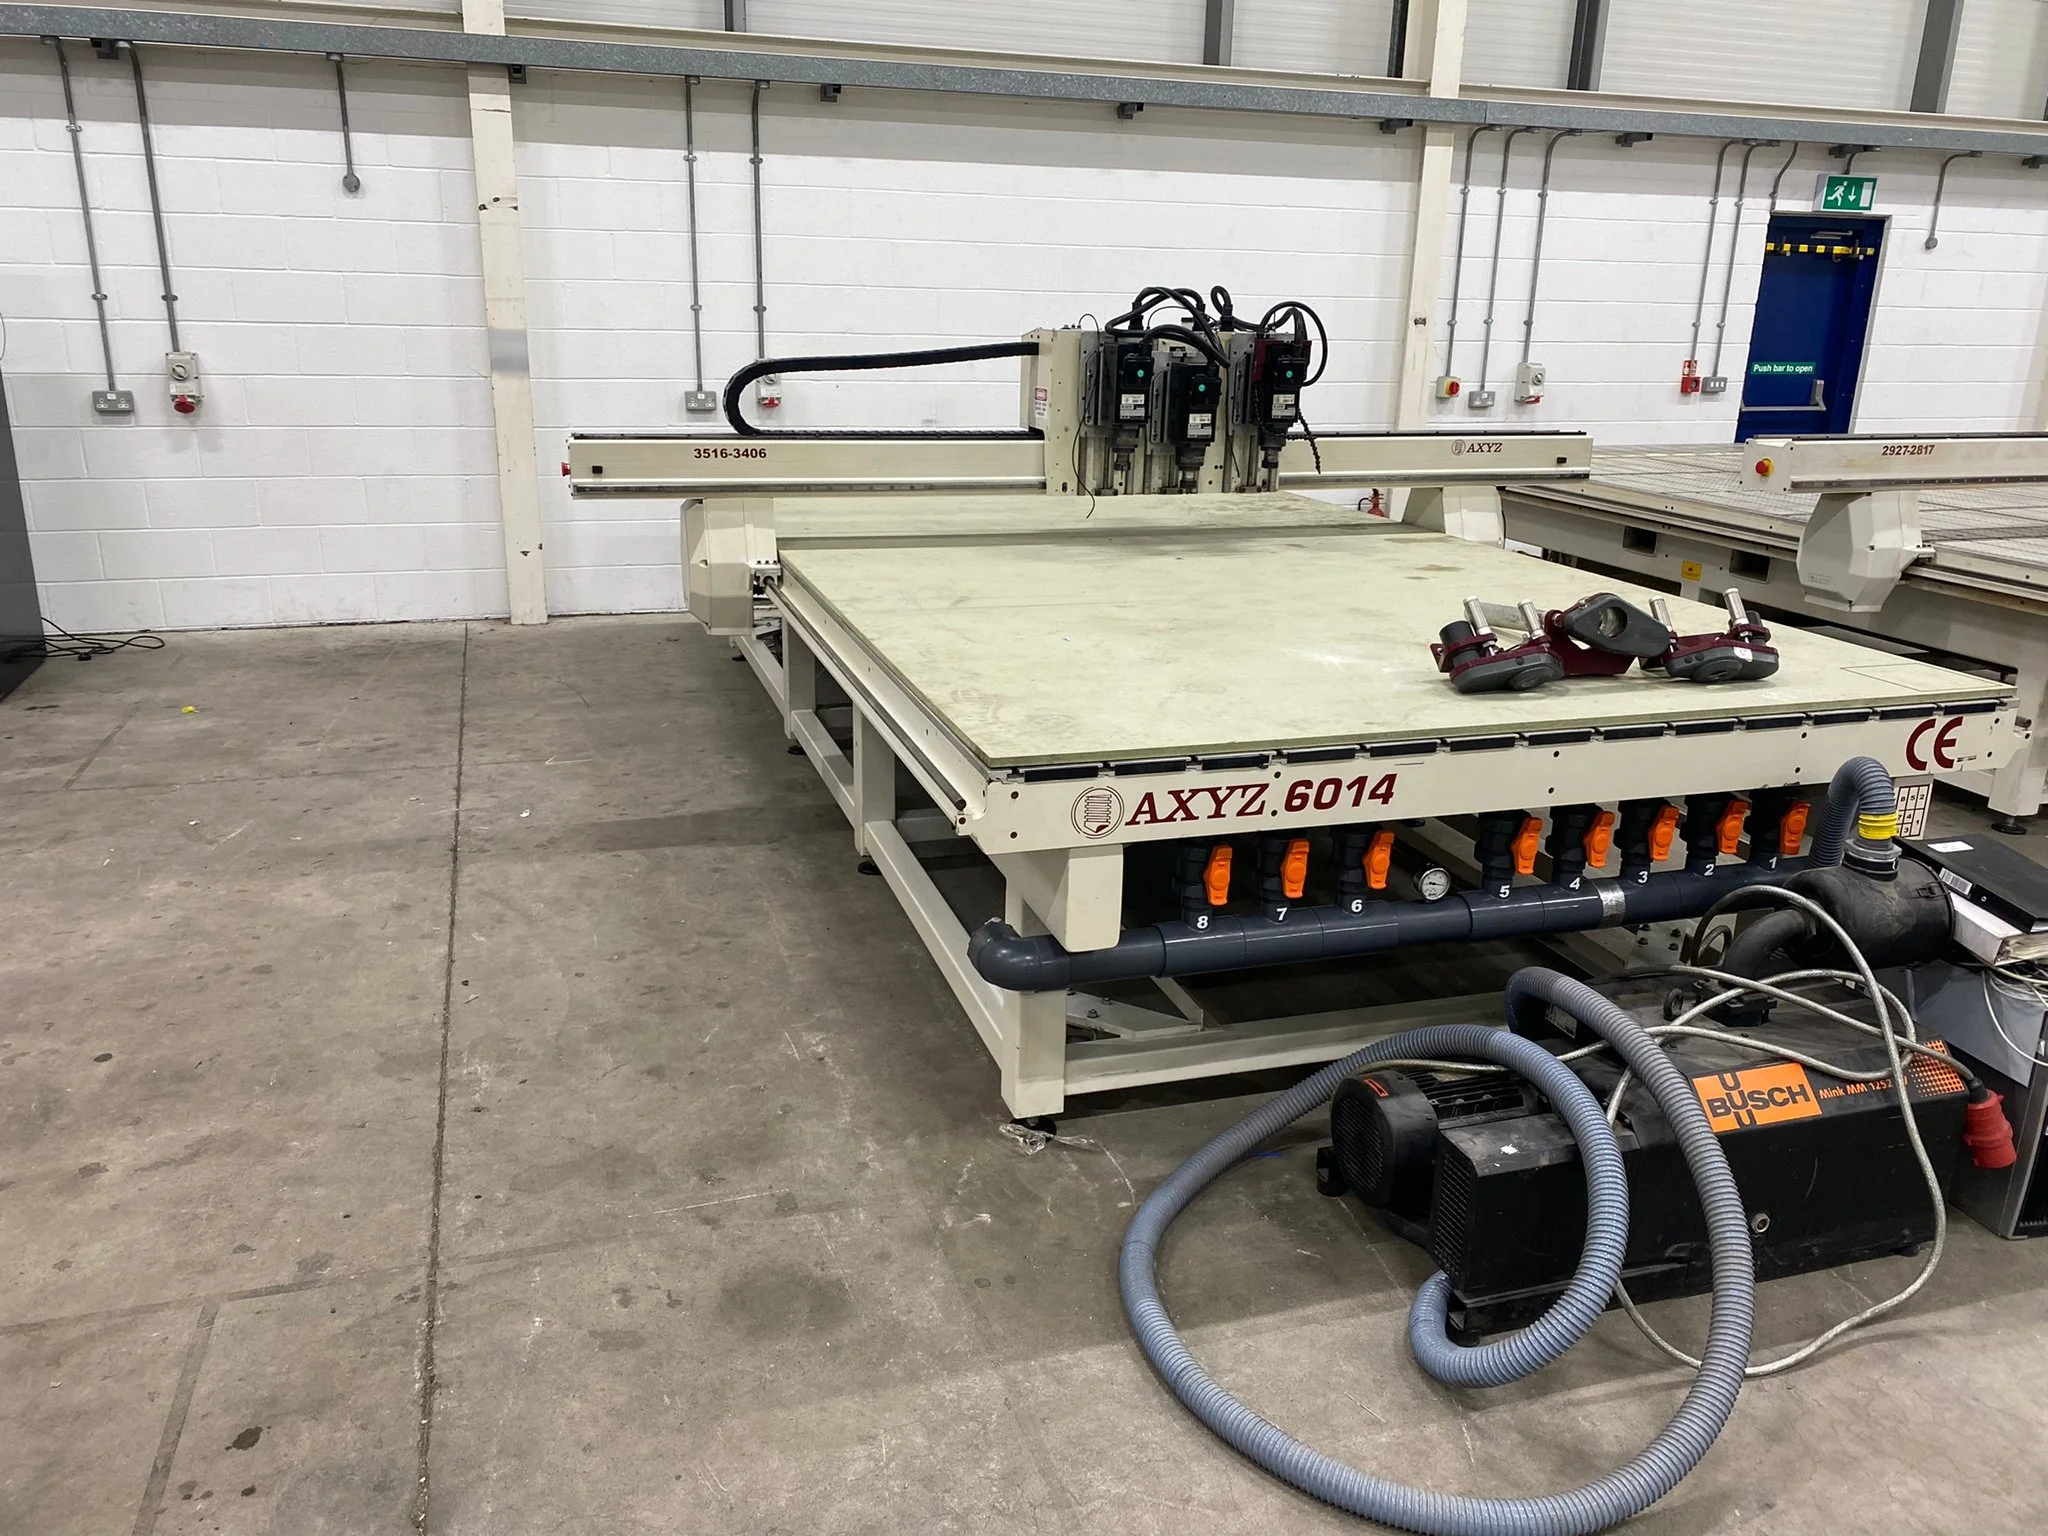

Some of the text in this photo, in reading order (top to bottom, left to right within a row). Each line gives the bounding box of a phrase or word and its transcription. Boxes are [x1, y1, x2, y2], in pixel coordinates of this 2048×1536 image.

[1753, 364, 1772, 372] Push
[1773, 364, 1786, 372] bar
[1795, 365, 1813, 374] open
[694, 448, 767, 459] 3516-3406
[1466, 442, 1503, 453] AXYZ
[1881, 444, 1936, 456] 2927-2817
[1906, 716, 1964, 771] CE
[1125, 773, 1398, 826] AXYZ 6014
[1703, 863, 1716, 876] 2
[1768, 857, 1778, 869] 1
[1569, 877, 1581, 890] 4
[1637, 871, 1648, 883] 3
[1499, 885, 1510, 898] 5
[1350, 899, 1363, 913] 6
[1276, 907, 1288, 921] 7
[1196, 915, 1209, 930] 8
[1820, 1086, 1845, 1099] Mink
[1845, 1083, 1868, 1095] MM
[1869, 1079, 1894, 1091] 1252
[1706, 1083, 1811, 1118] BUSCH
